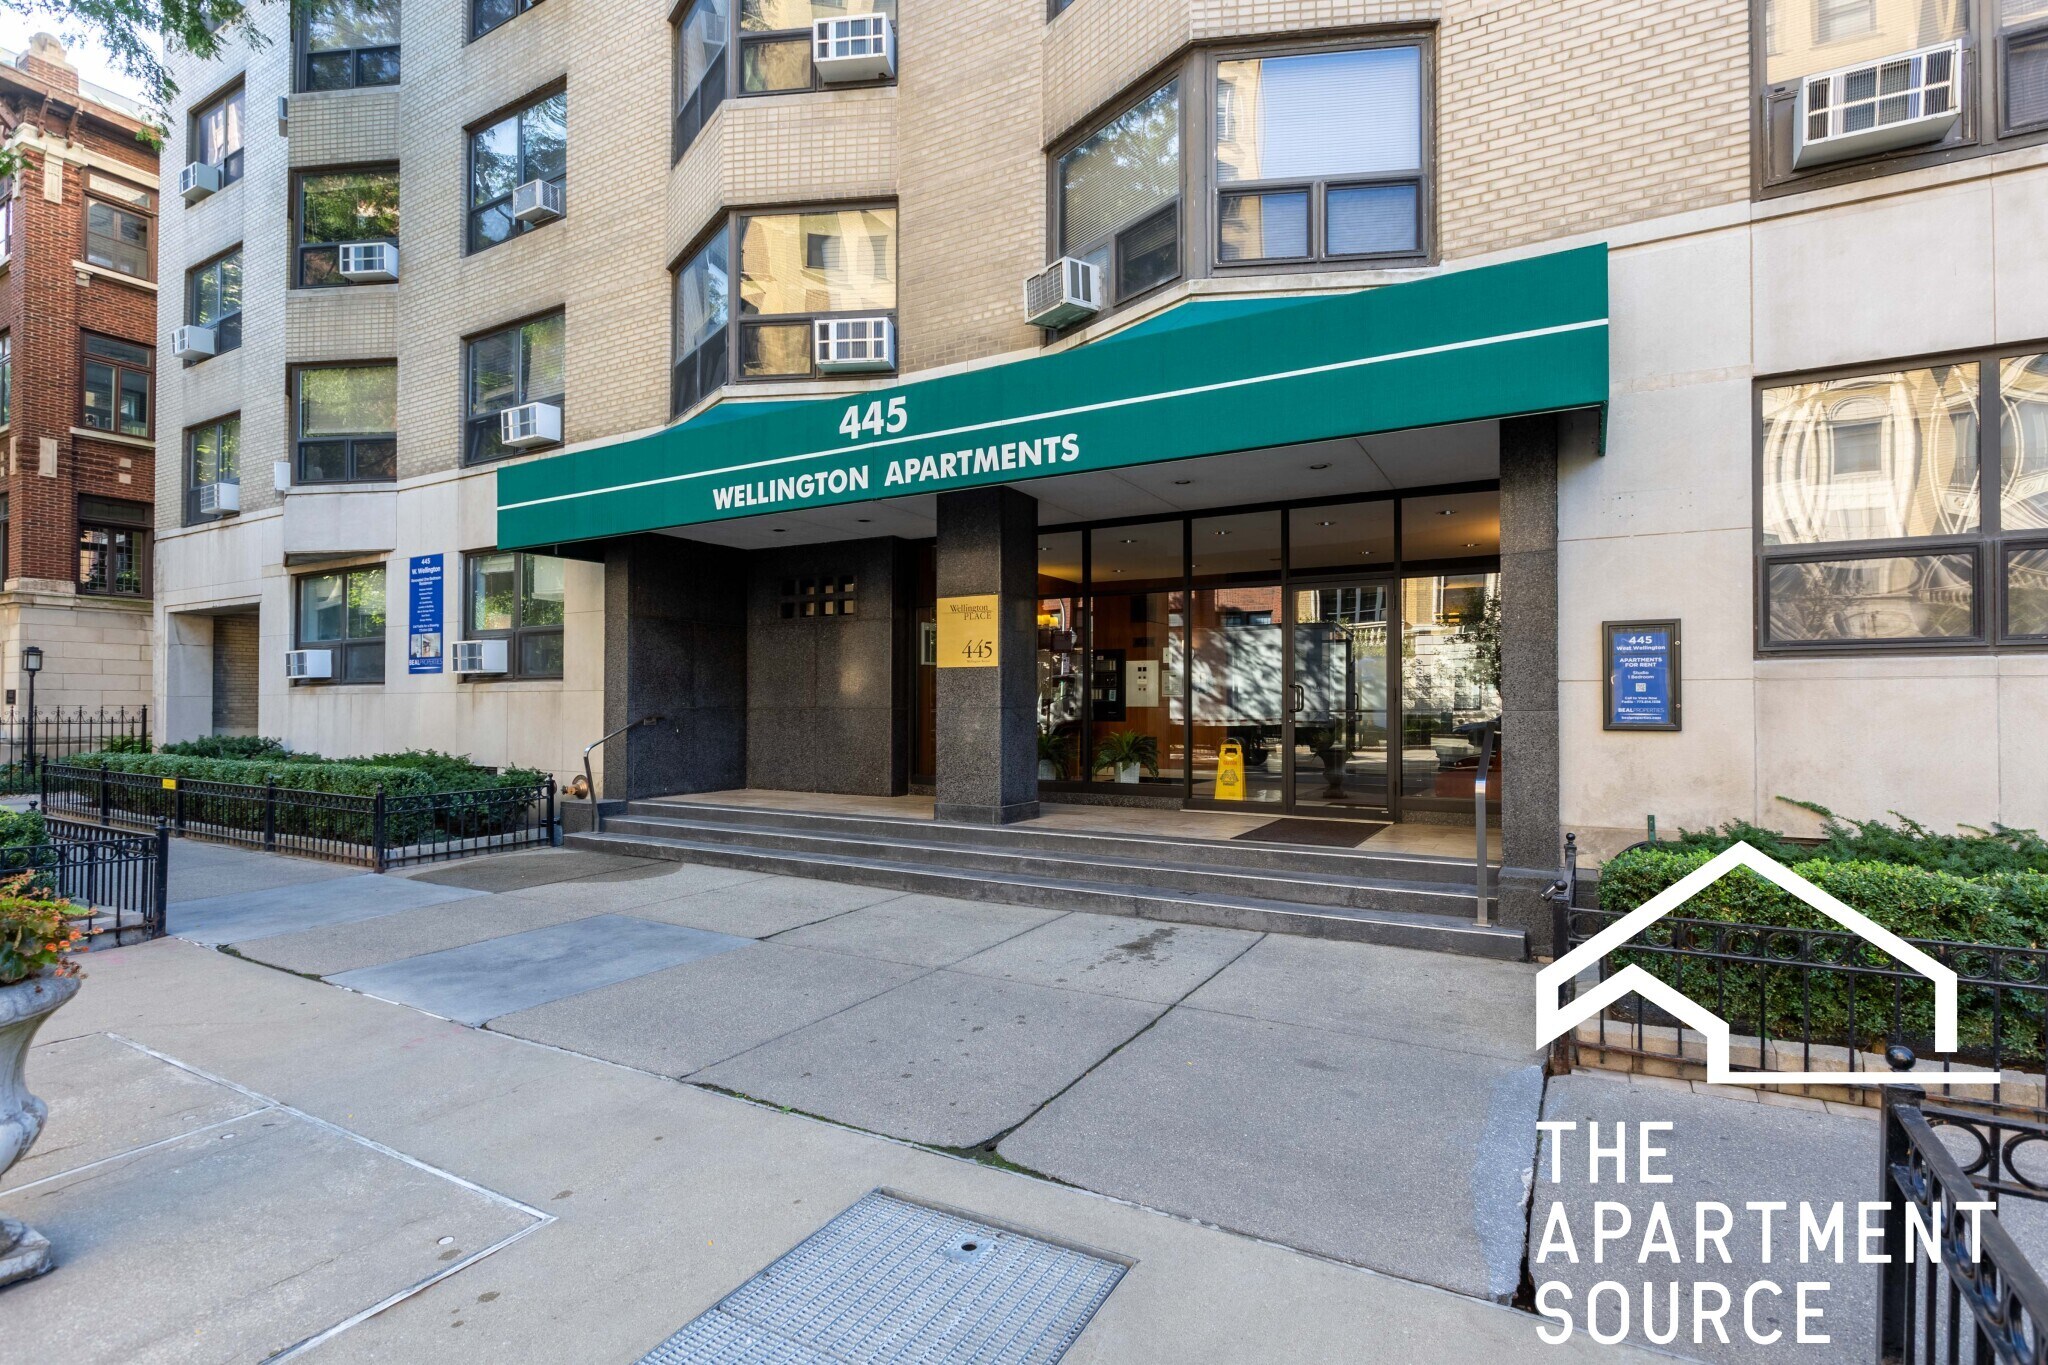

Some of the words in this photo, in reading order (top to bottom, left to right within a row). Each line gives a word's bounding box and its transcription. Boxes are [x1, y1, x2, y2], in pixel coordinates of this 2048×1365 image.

[839, 396, 908, 440] 445
[713, 465, 869, 510] WELLINGTON
[884, 433, 1080, 487] APARTMENTS
[950, 604, 988, 613] Wellington
[964, 612, 992, 620] PLACE
[1629, 636, 1652, 644] 445
[962, 639, 992, 658] 445
